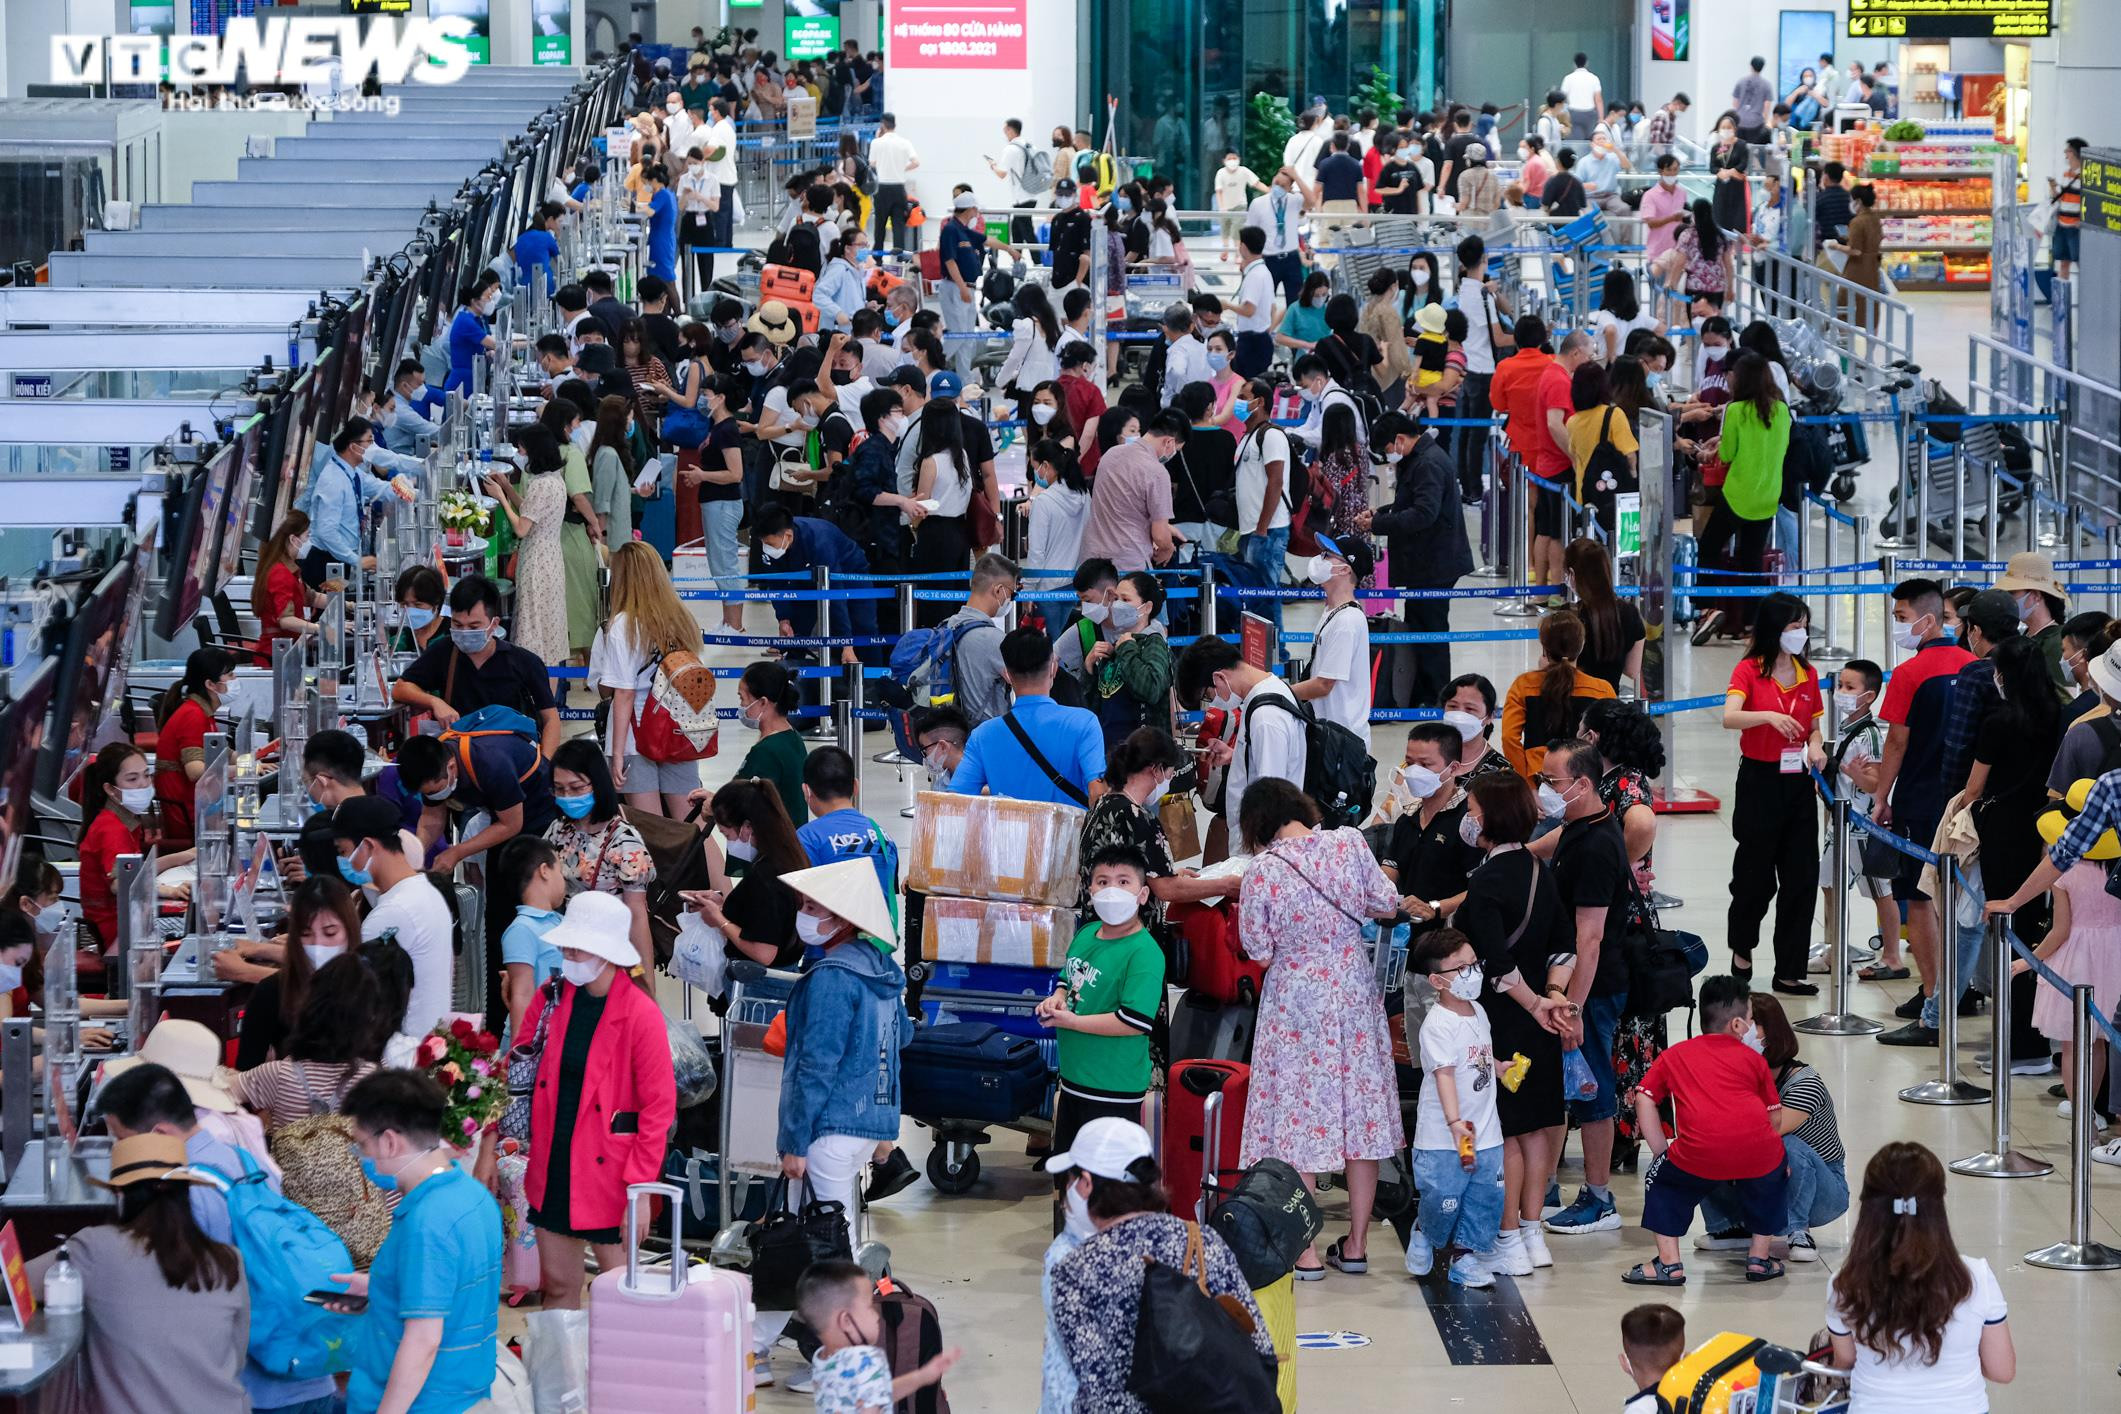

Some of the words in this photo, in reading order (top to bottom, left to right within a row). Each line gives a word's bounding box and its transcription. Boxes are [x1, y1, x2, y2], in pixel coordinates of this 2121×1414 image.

[961, 20, 987, 37] CỬA
[987, 21, 1022, 37] HÀNG
[1423, 589, 1470, 598] INTERNATIONAL
[1473, 588, 1500, 597] AIRPORT
[748, 637, 771, 646] NOIBAI
[773, 637, 823, 646] INTERNATIONAL
[826, 637, 854, 646] AIRPORT
[870, 636, 887, 644] N.I.A
